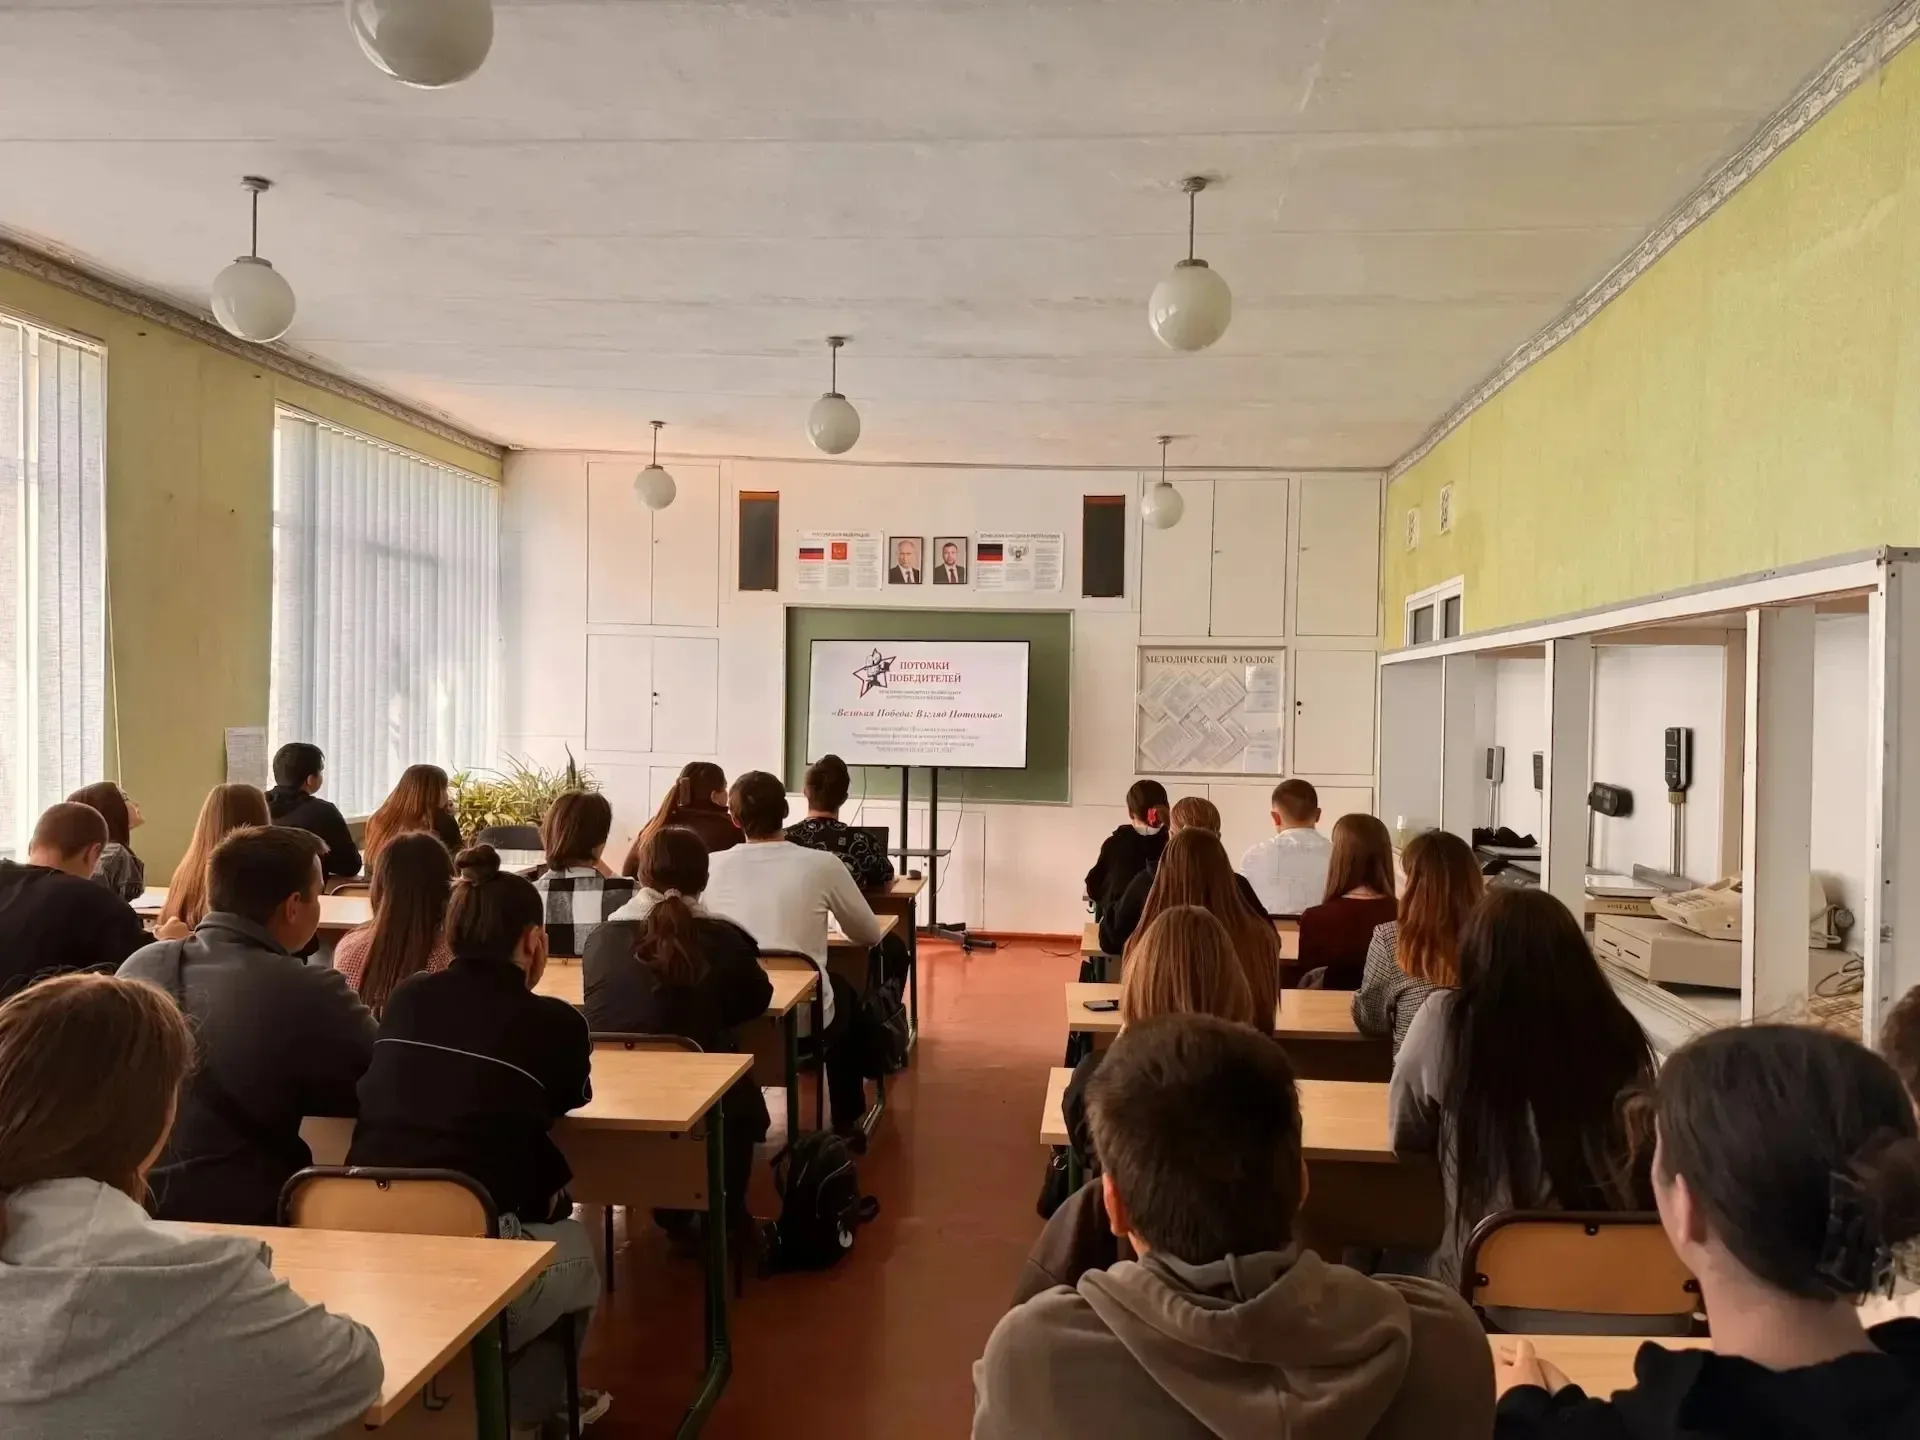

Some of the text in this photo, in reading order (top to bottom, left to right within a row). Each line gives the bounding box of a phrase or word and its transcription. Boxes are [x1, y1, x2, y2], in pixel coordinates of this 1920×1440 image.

[1145, 654, 1275, 664] МЕТОДИЧЕСКИЙ УГОЛОК
[900, 661, 949, 670] ПОТОМКИ
[889, 672, 961, 684] ПОБЕДИТЕЛЕЙ
[831, 708, 1003, 719] «Великая Победа: Взгляд Потомков»
